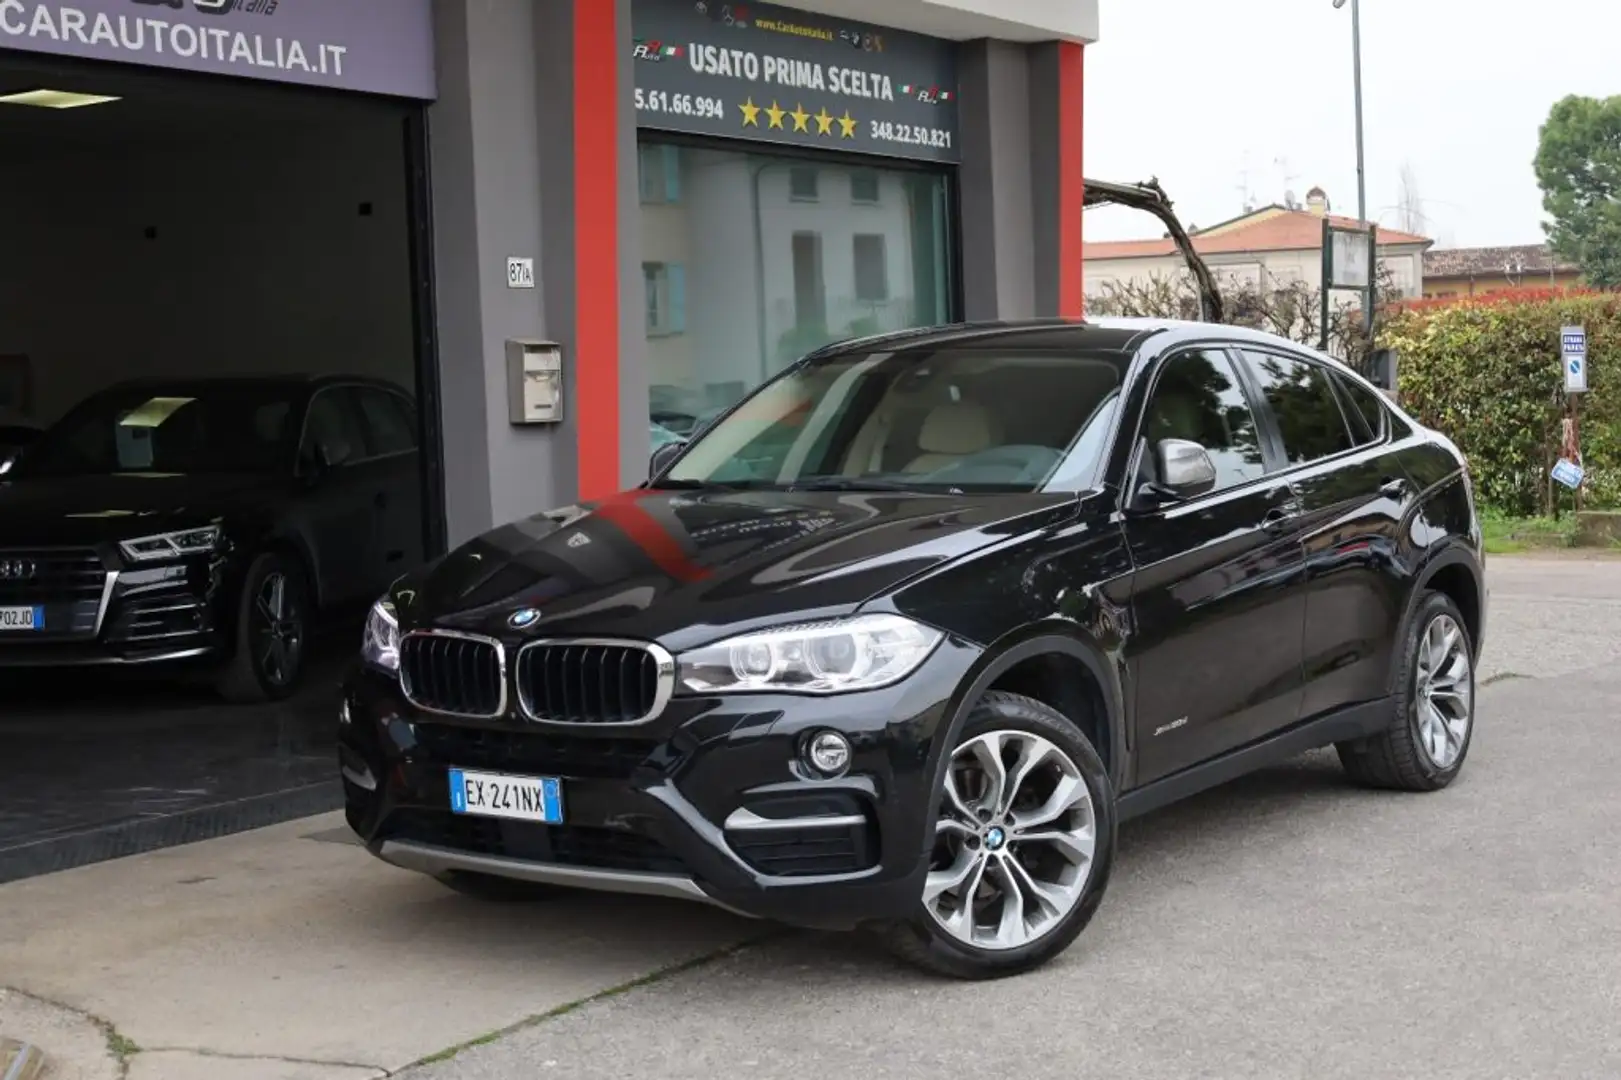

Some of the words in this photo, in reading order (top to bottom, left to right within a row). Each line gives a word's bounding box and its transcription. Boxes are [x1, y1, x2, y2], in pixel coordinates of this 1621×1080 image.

[0, 2, 347, 76] CARAUTOITALIA.IT
[689, 42, 759, 81] USATO
[763, 55, 824, 91] PRIMA
[828, 65, 894, 101] SCELTA
[870, 120, 951, 148] 348.22.50.821
[465, 779, 486, 806] EX
[490, 783, 543, 812] 241NX
